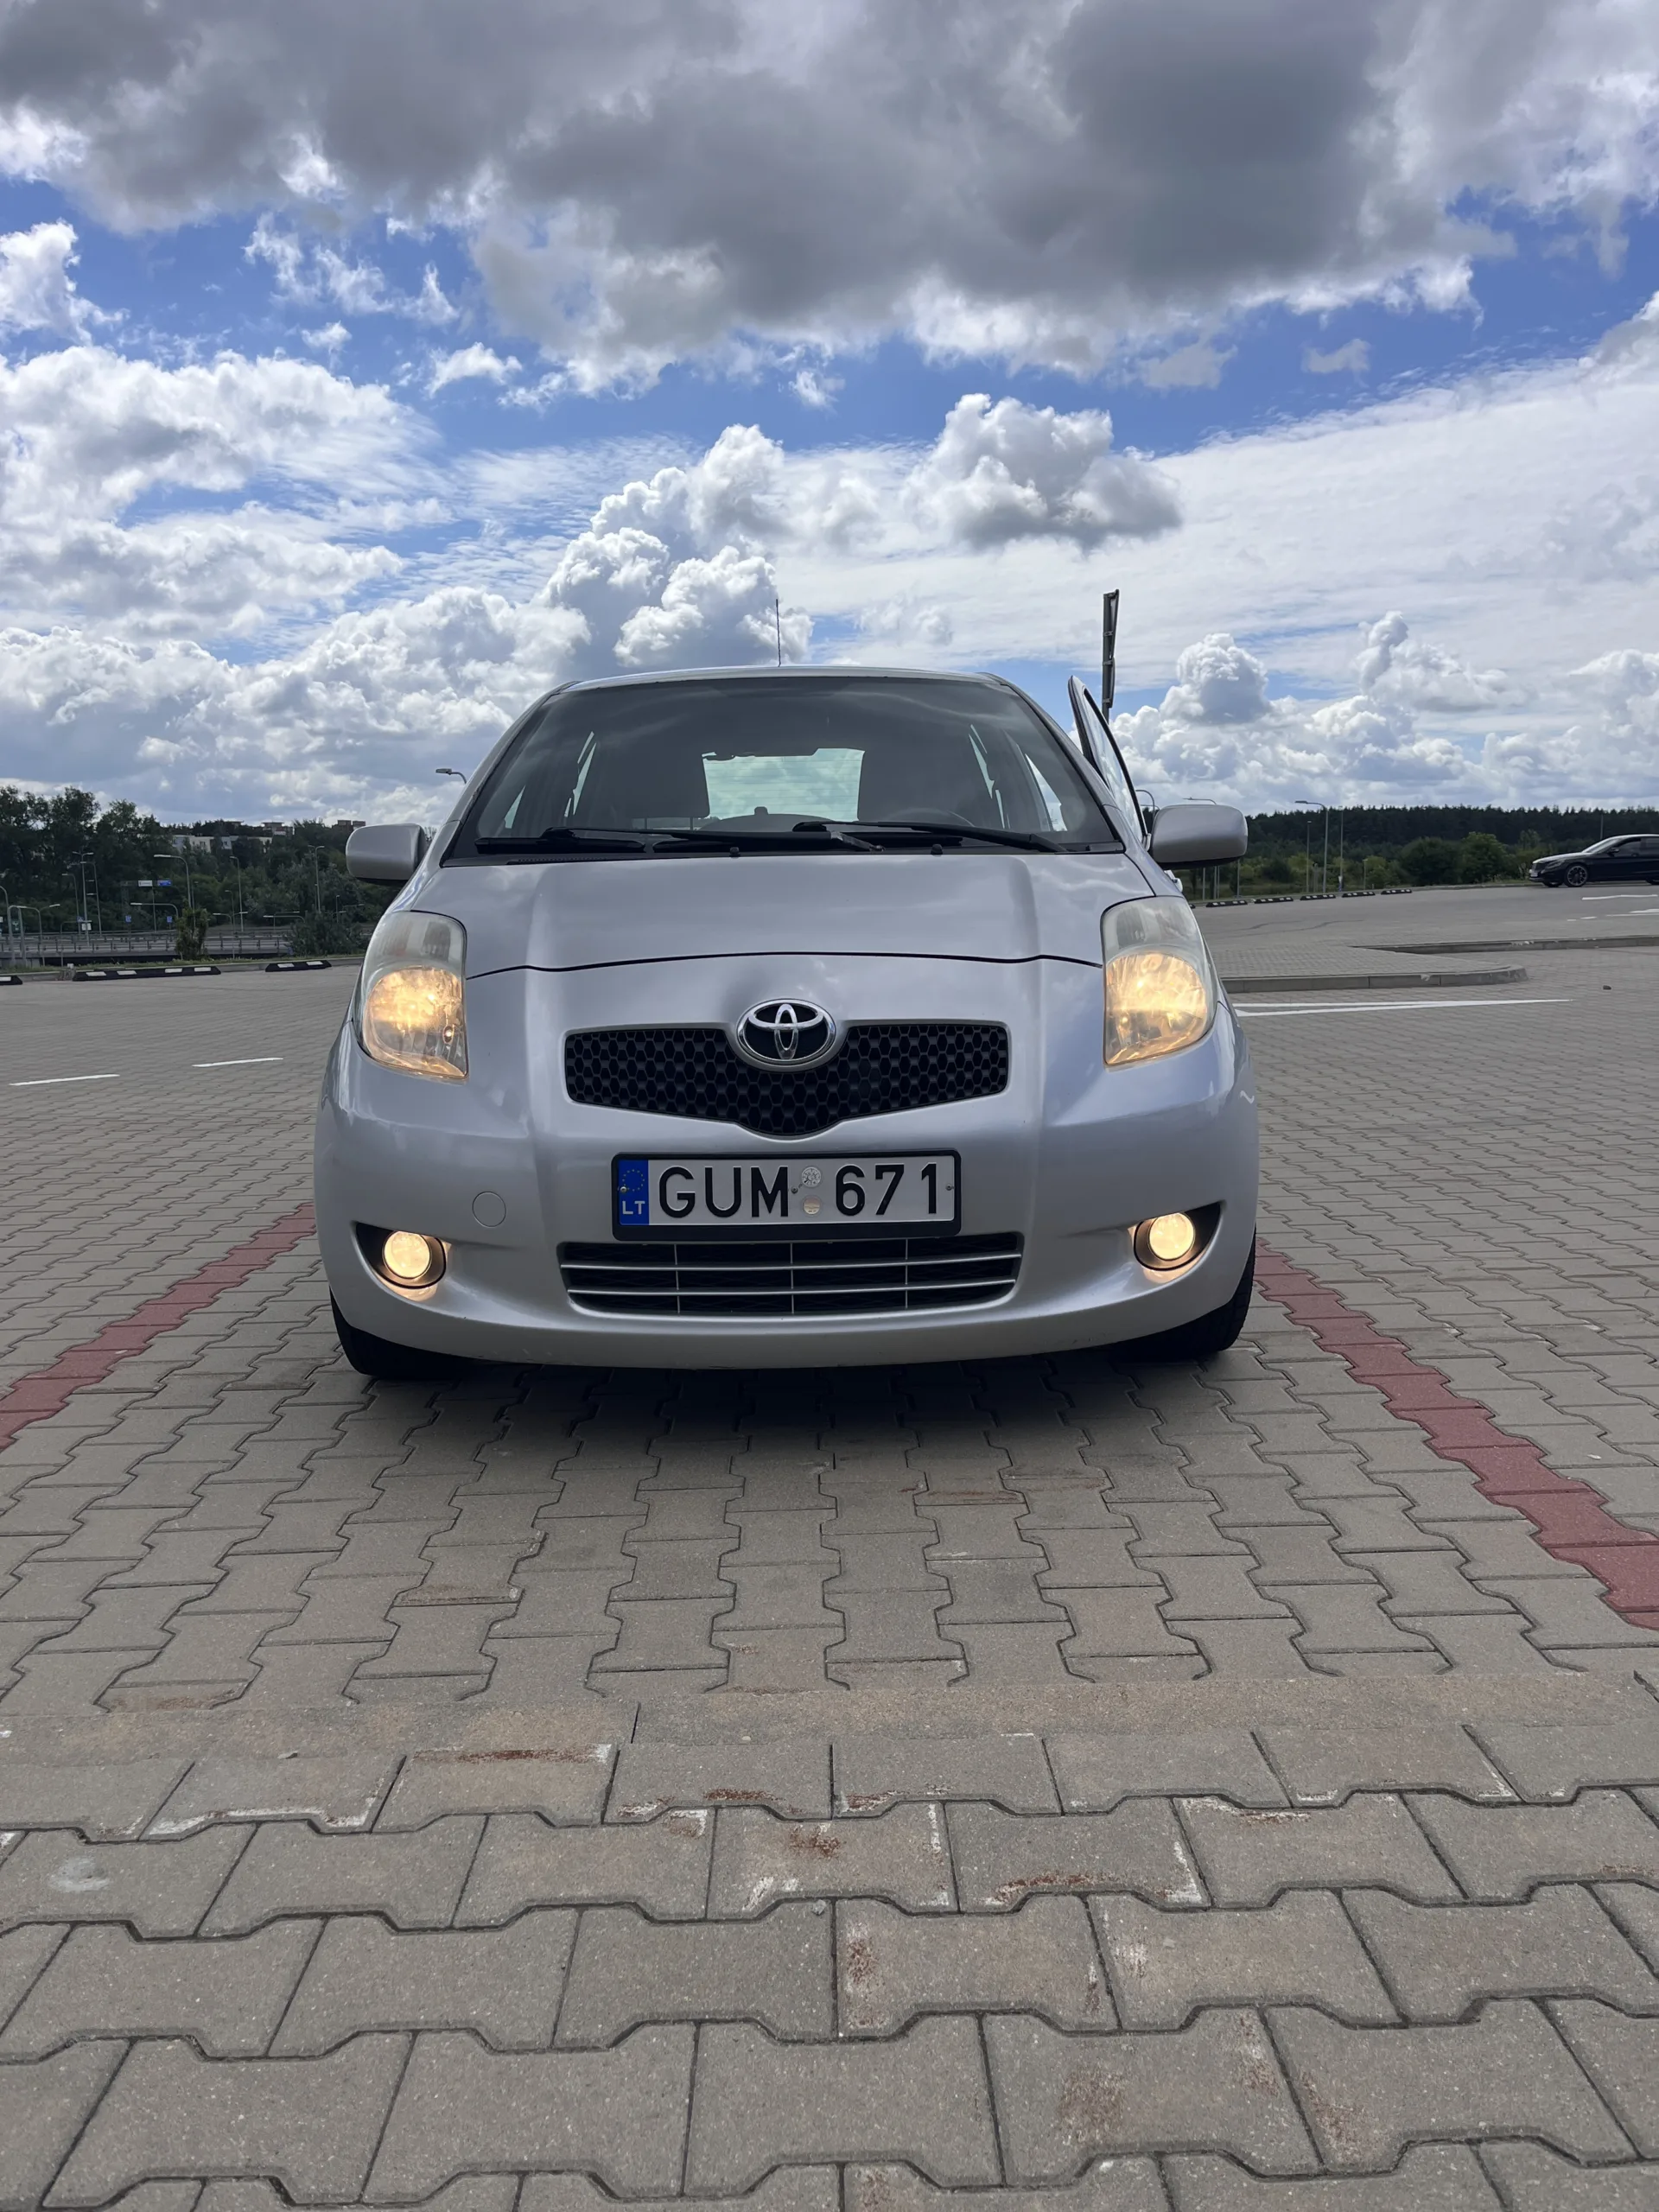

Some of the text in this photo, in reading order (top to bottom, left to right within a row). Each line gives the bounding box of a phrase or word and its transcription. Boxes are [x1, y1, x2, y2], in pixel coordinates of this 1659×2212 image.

[622, 1200, 645, 1215] LT
[658, 1163, 937, 1218] GUM 671
